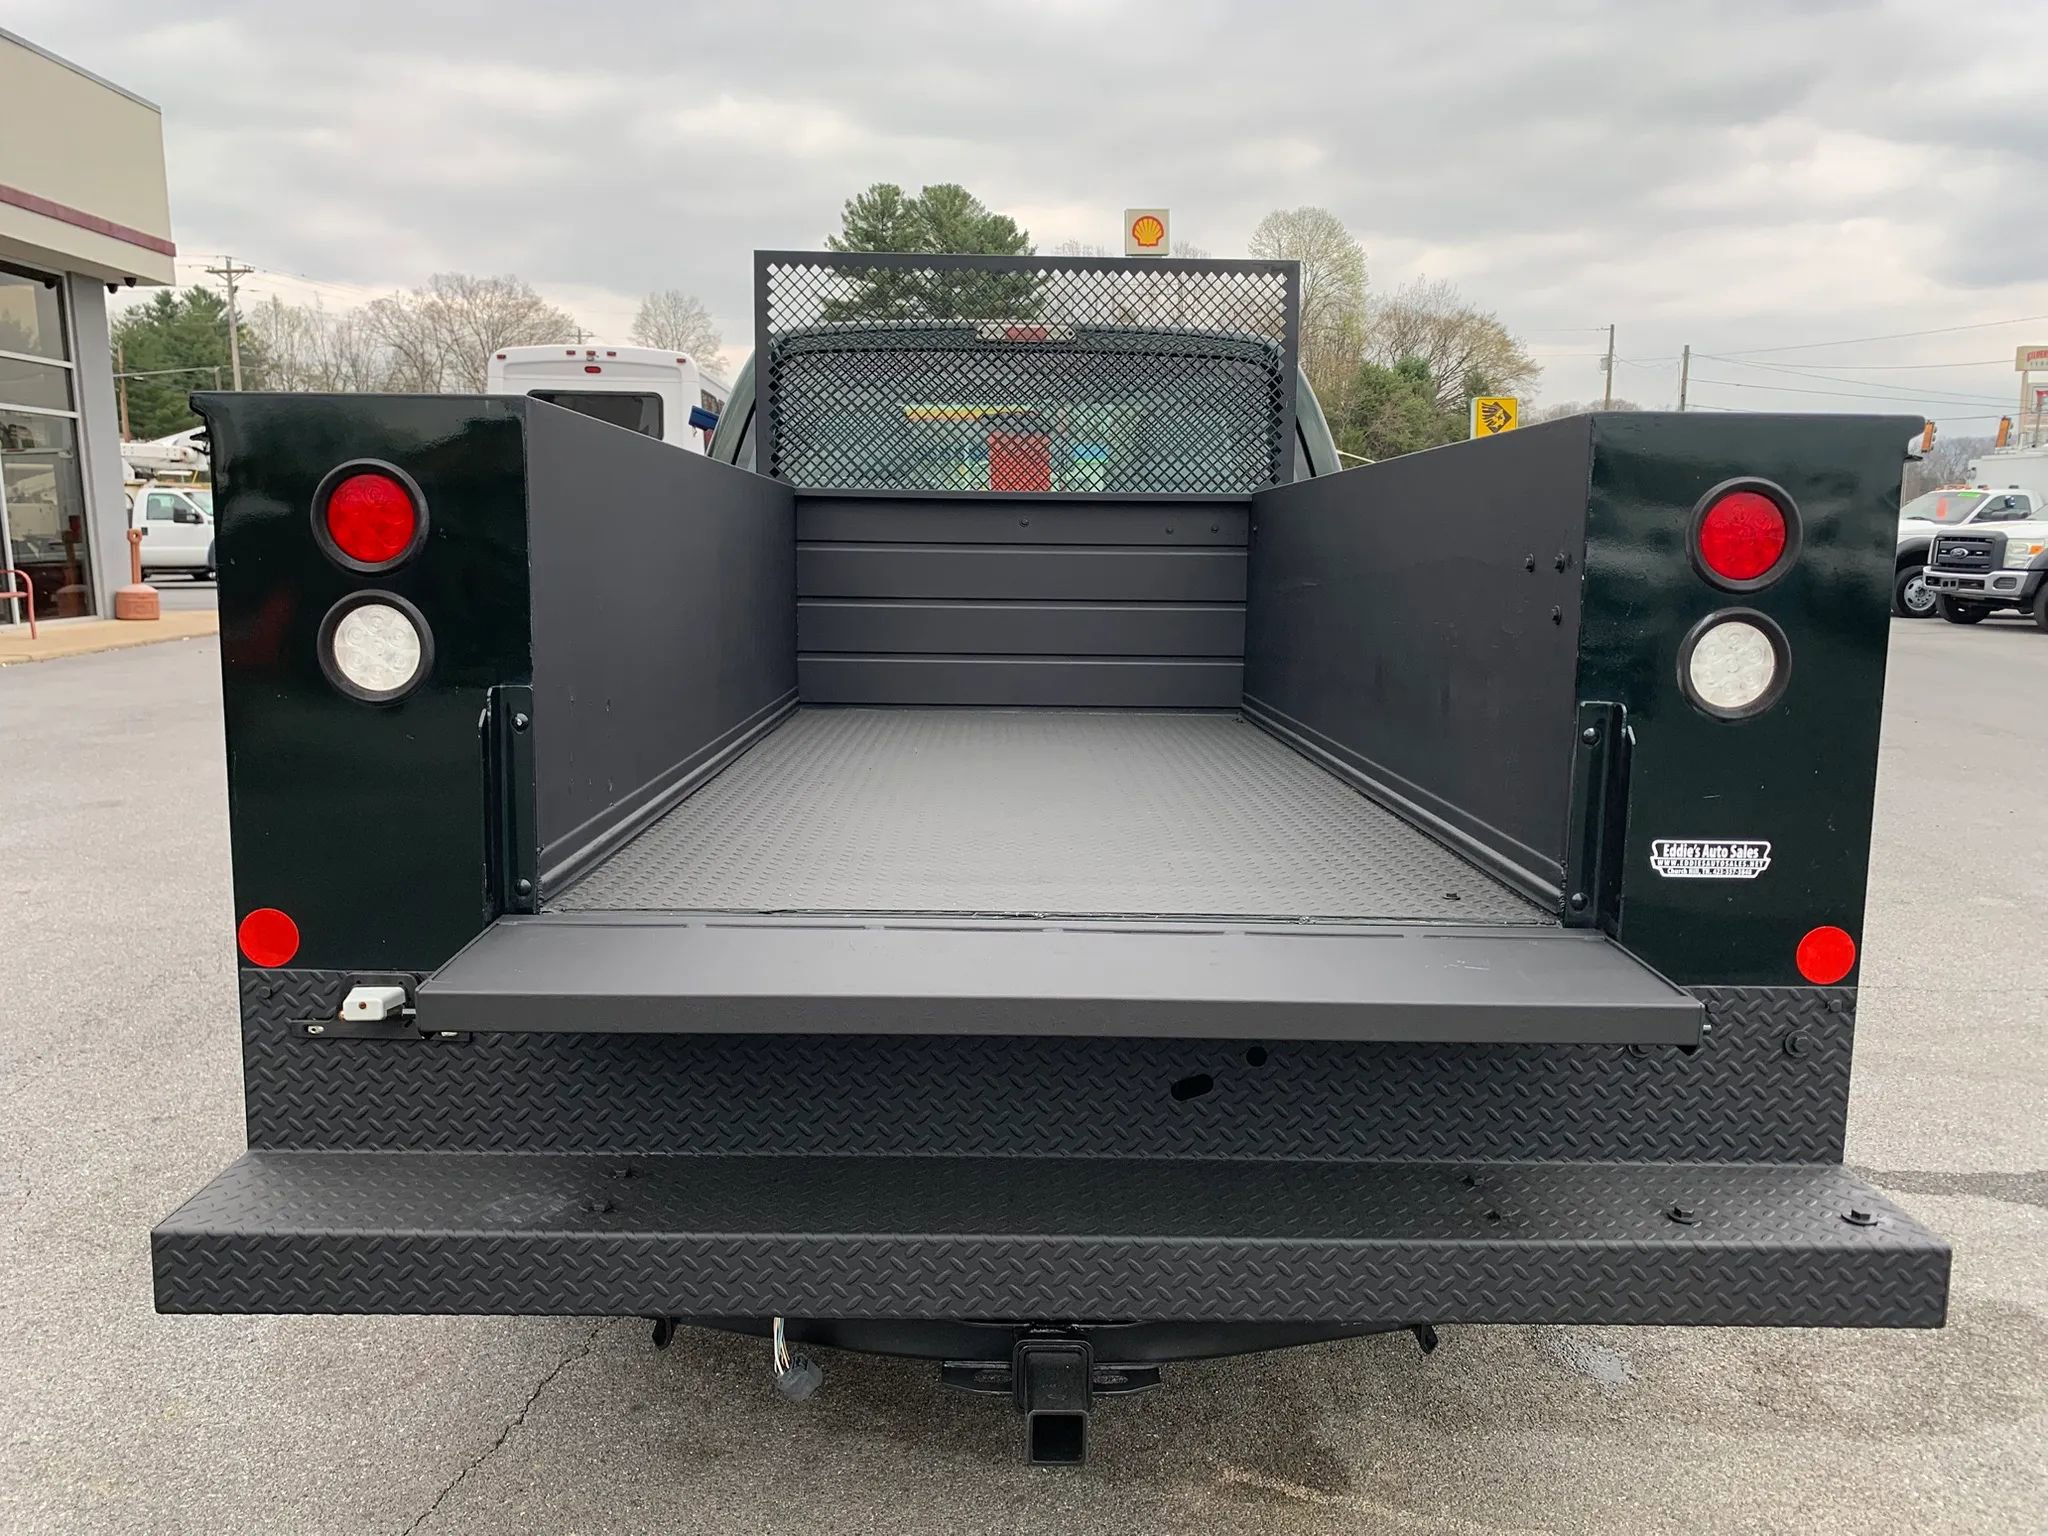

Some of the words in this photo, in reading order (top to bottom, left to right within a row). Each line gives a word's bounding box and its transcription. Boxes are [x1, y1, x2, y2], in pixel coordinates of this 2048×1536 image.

[1663, 844, 1700, 858] Eddie's
[1702, 844, 1728, 858] Auto
[1730, 845, 1759, 859] Sales
[1657, 859, 1763, 868] WWW.EDDIESAUTOSALES.NET
